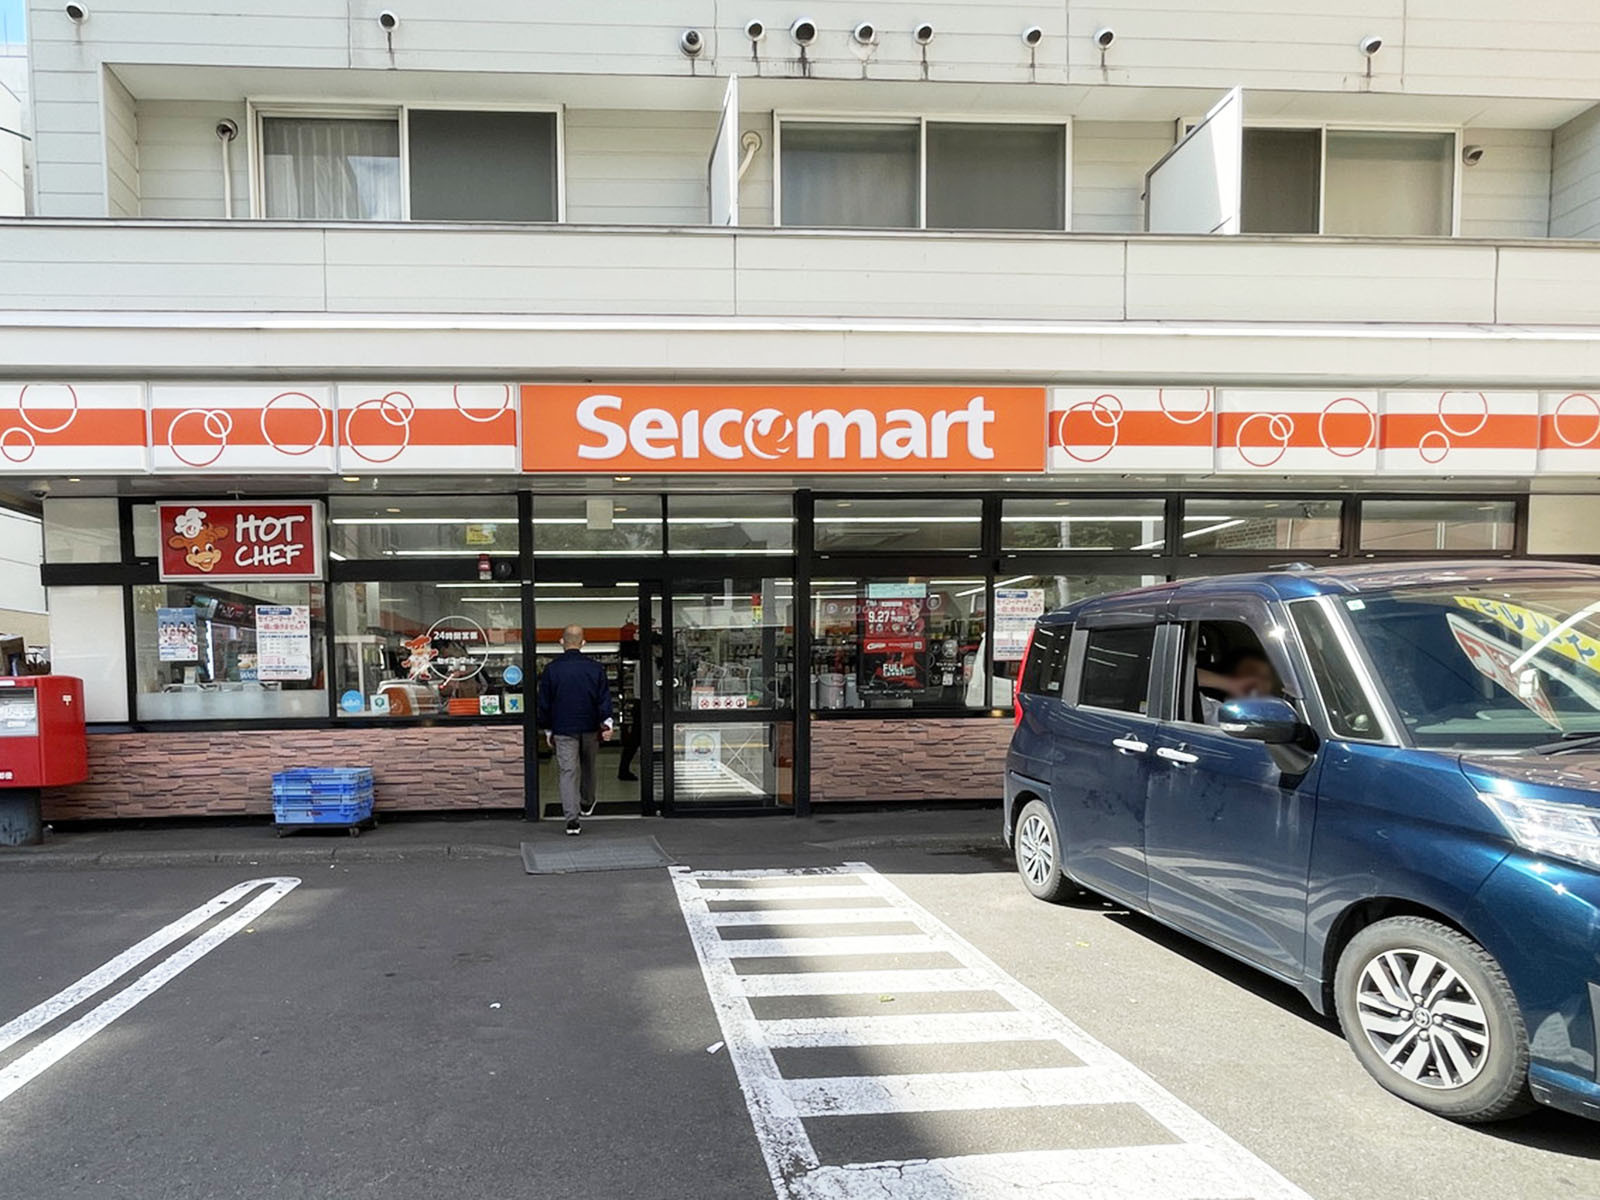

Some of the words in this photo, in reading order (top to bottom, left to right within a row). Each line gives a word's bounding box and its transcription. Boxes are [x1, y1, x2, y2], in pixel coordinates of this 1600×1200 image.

[575, 394, 996, 460] Seicomart
[236, 513, 305, 543] HOT
[235, 544, 304, 567] CHEF
[868, 610, 890, 623] 9.27
